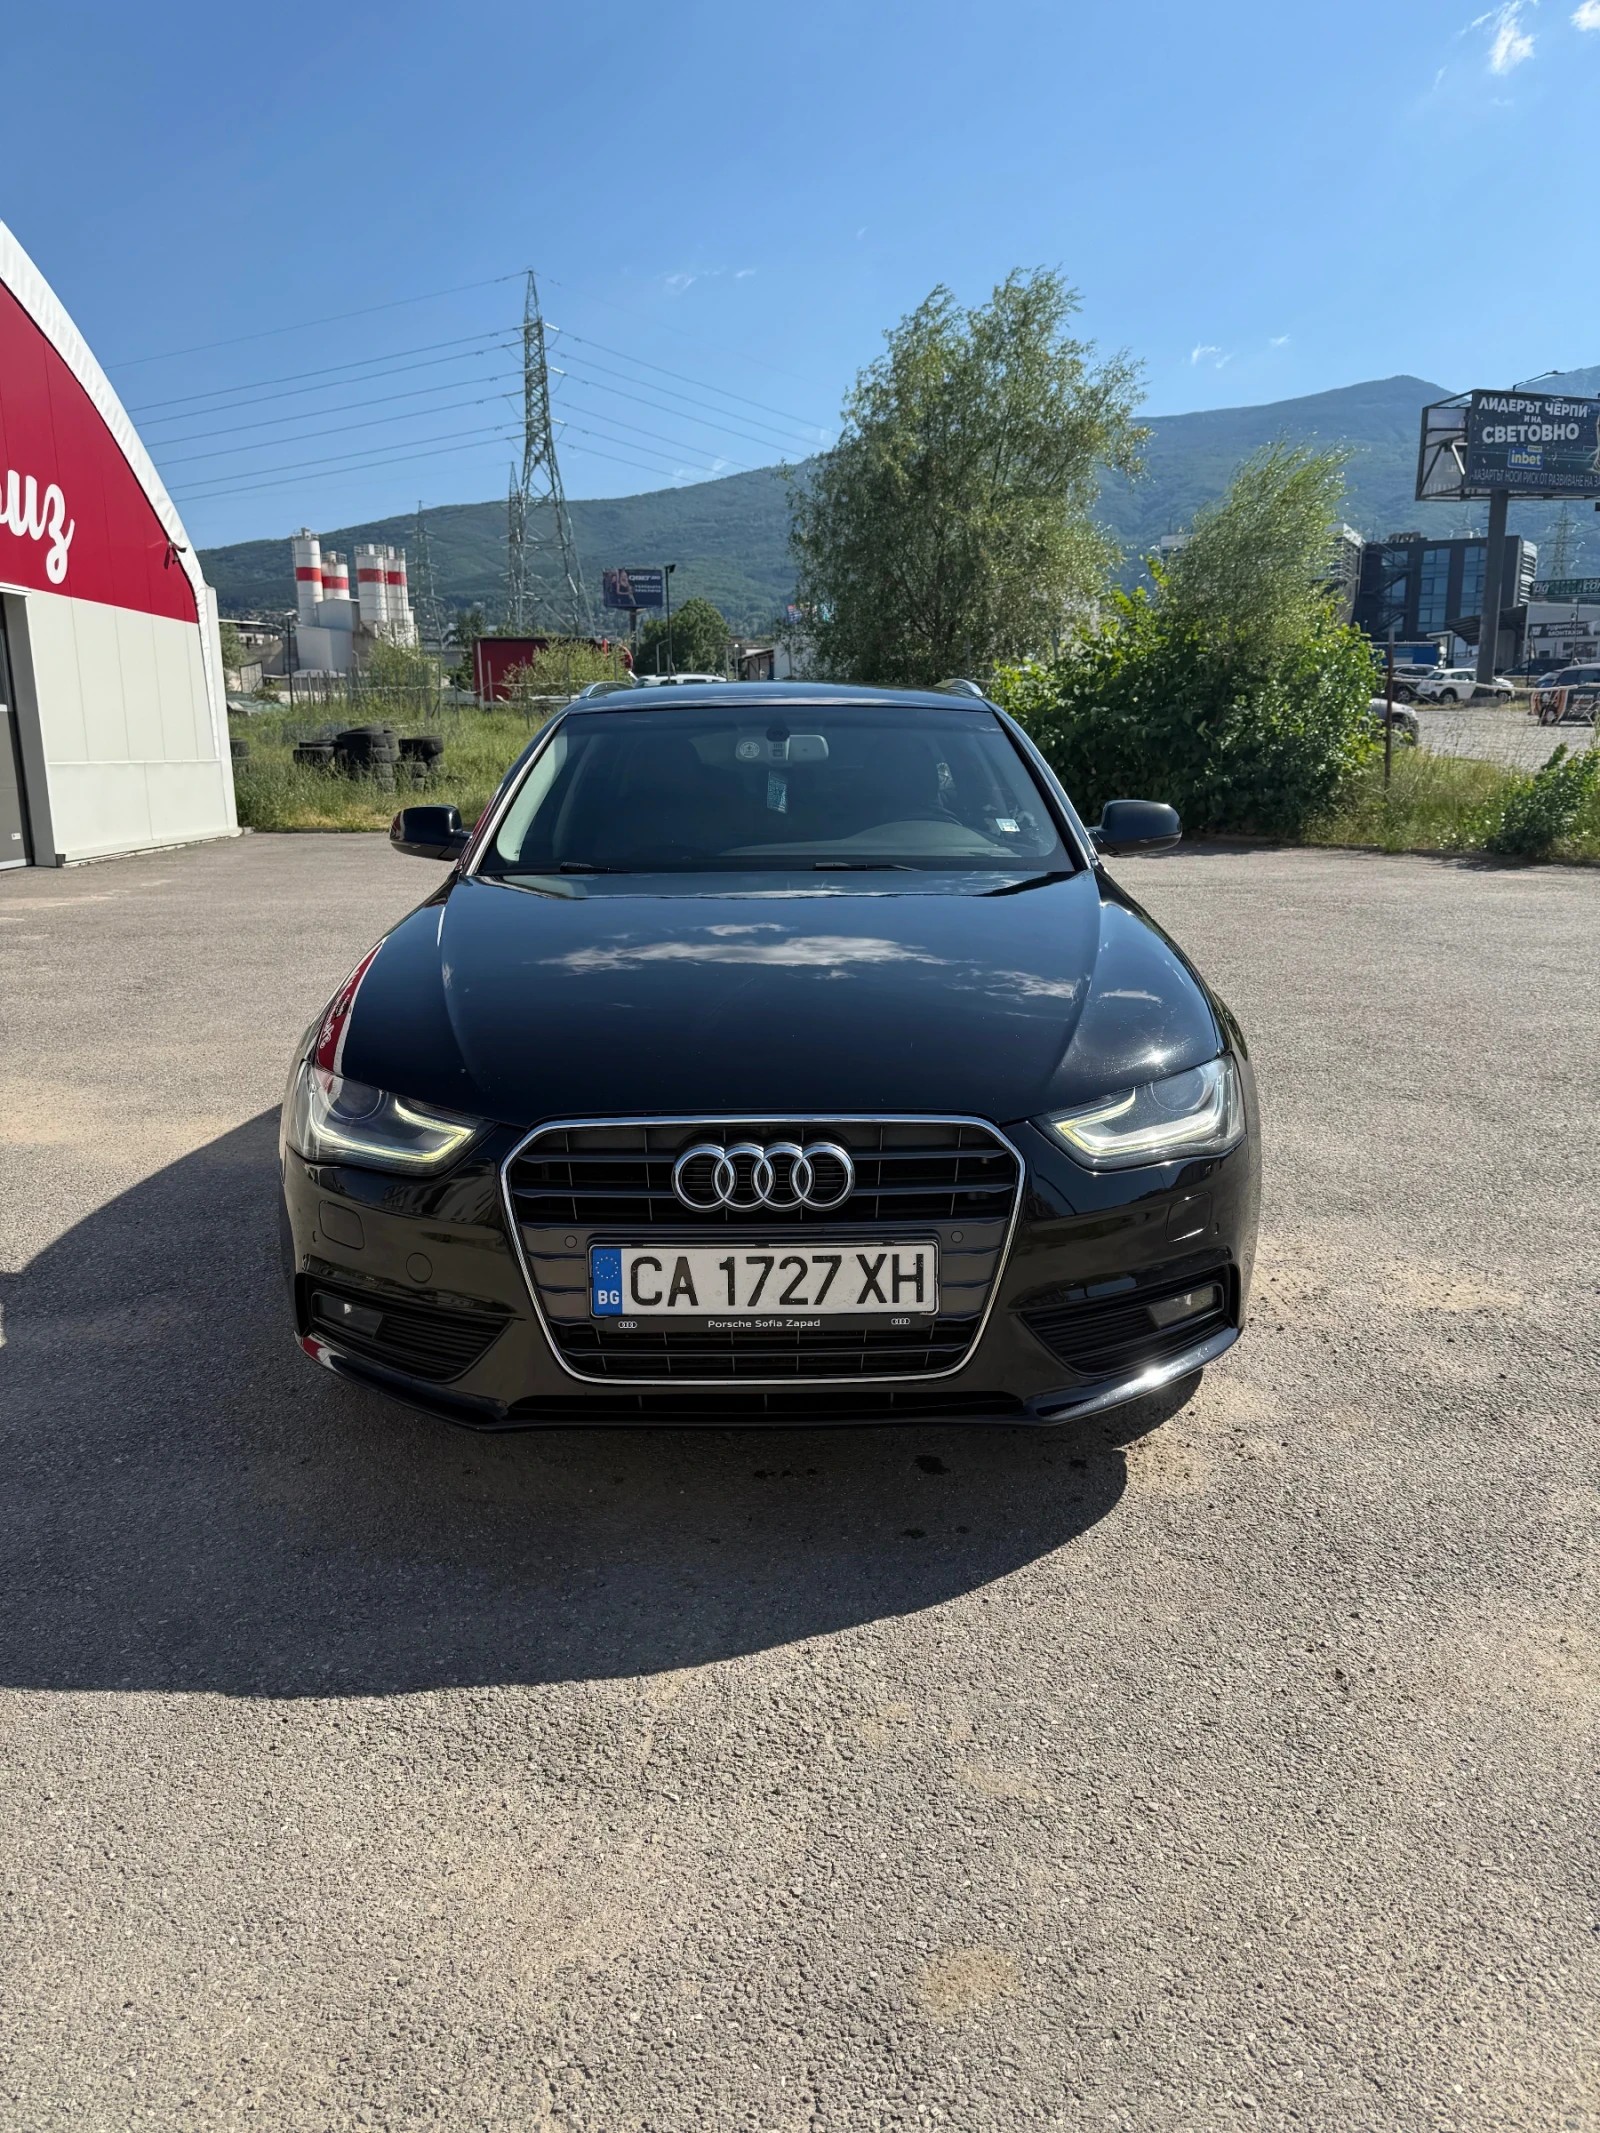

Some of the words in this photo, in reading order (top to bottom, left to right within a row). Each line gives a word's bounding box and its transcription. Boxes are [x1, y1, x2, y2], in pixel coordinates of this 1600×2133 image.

[1478, 397, 1542, 414] ЛИДЕРЪТ
[1545, 401, 1588, 418] ЧЕРПИ
[1523, 415, 1530, 423] И
[1531, 415, 1542, 423] НА
[1482, 423, 1580, 444] СВЕТОВНО
[1511, 451, 1542, 466] inbet
[1505, 470, 1522, 483] НОСИ
[1523, 472, 1539, 484] РИСК
[1540, 473, 1548, 485] ОТ
[630, 1256, 699, 1307] CA
[719, 1255, 842, 1307] 1727
[855, 1253, 925, 1305] XH
[597, 1290, 620, 1305] BG
[708, 1320, 752, 1329] Porsche
[755, 1319, 783, 1328] Sofia
[785, 1318, 821, 1329] Zapad
